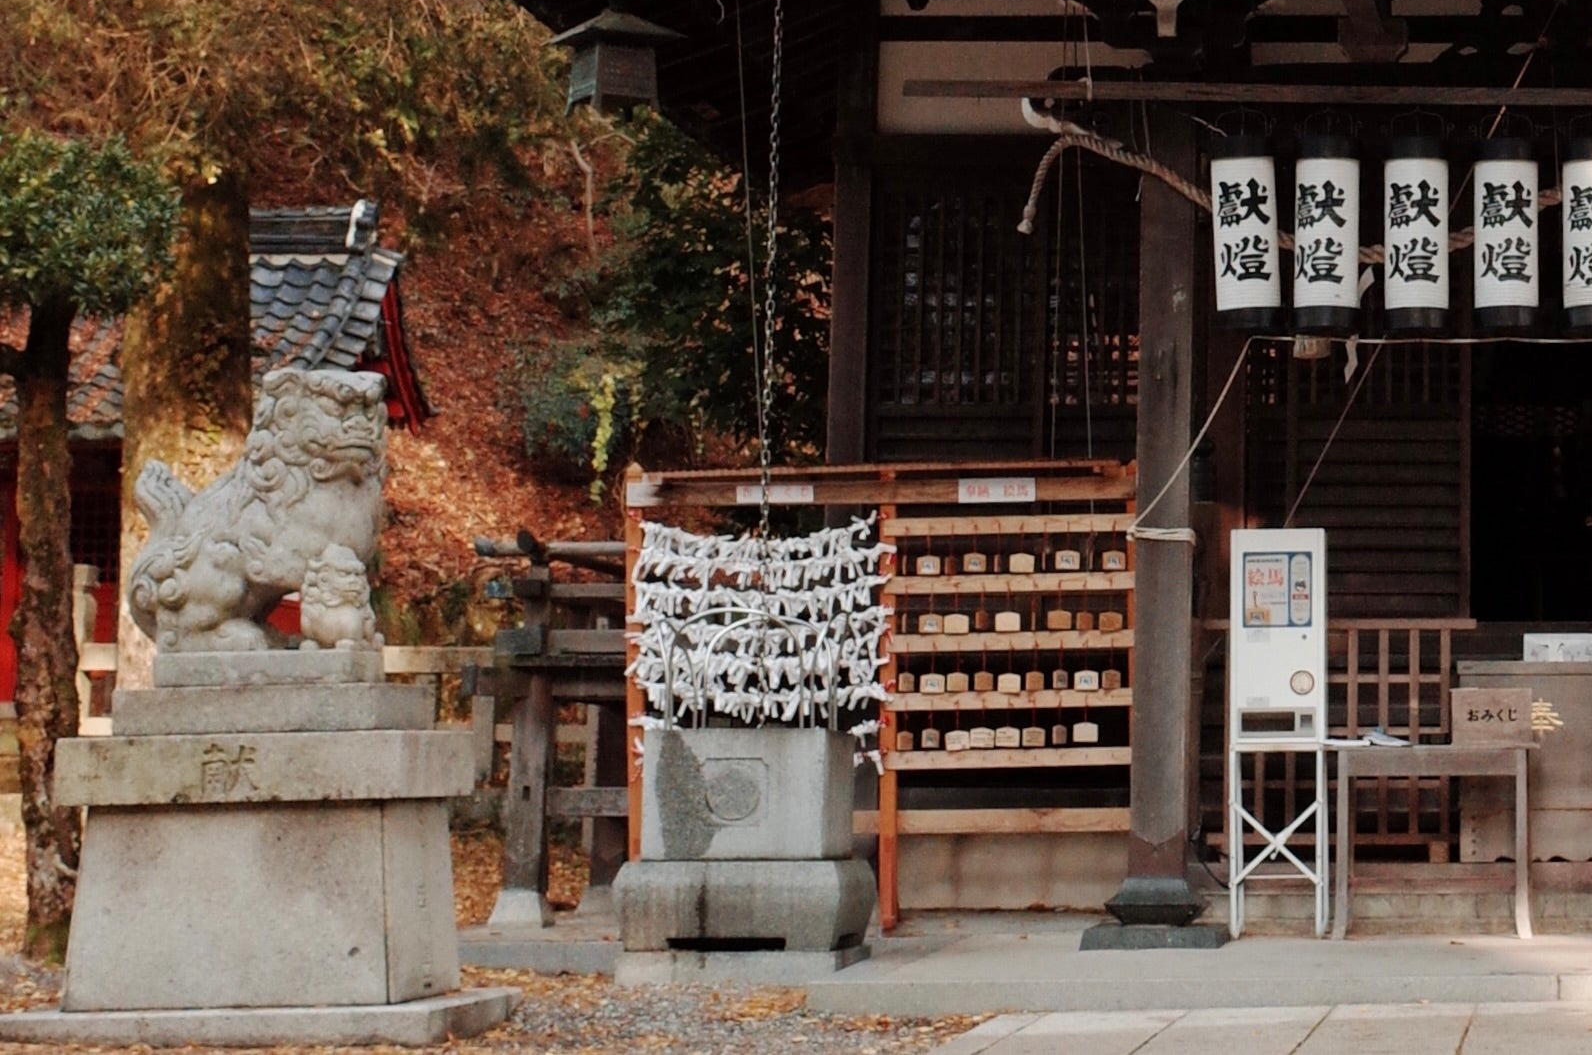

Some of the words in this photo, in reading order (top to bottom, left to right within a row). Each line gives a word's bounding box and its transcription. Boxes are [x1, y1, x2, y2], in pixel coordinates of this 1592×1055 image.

[1247, 568, 1284, 587] 絵馬
[1466, 707, 1518, 723] おみくじ
